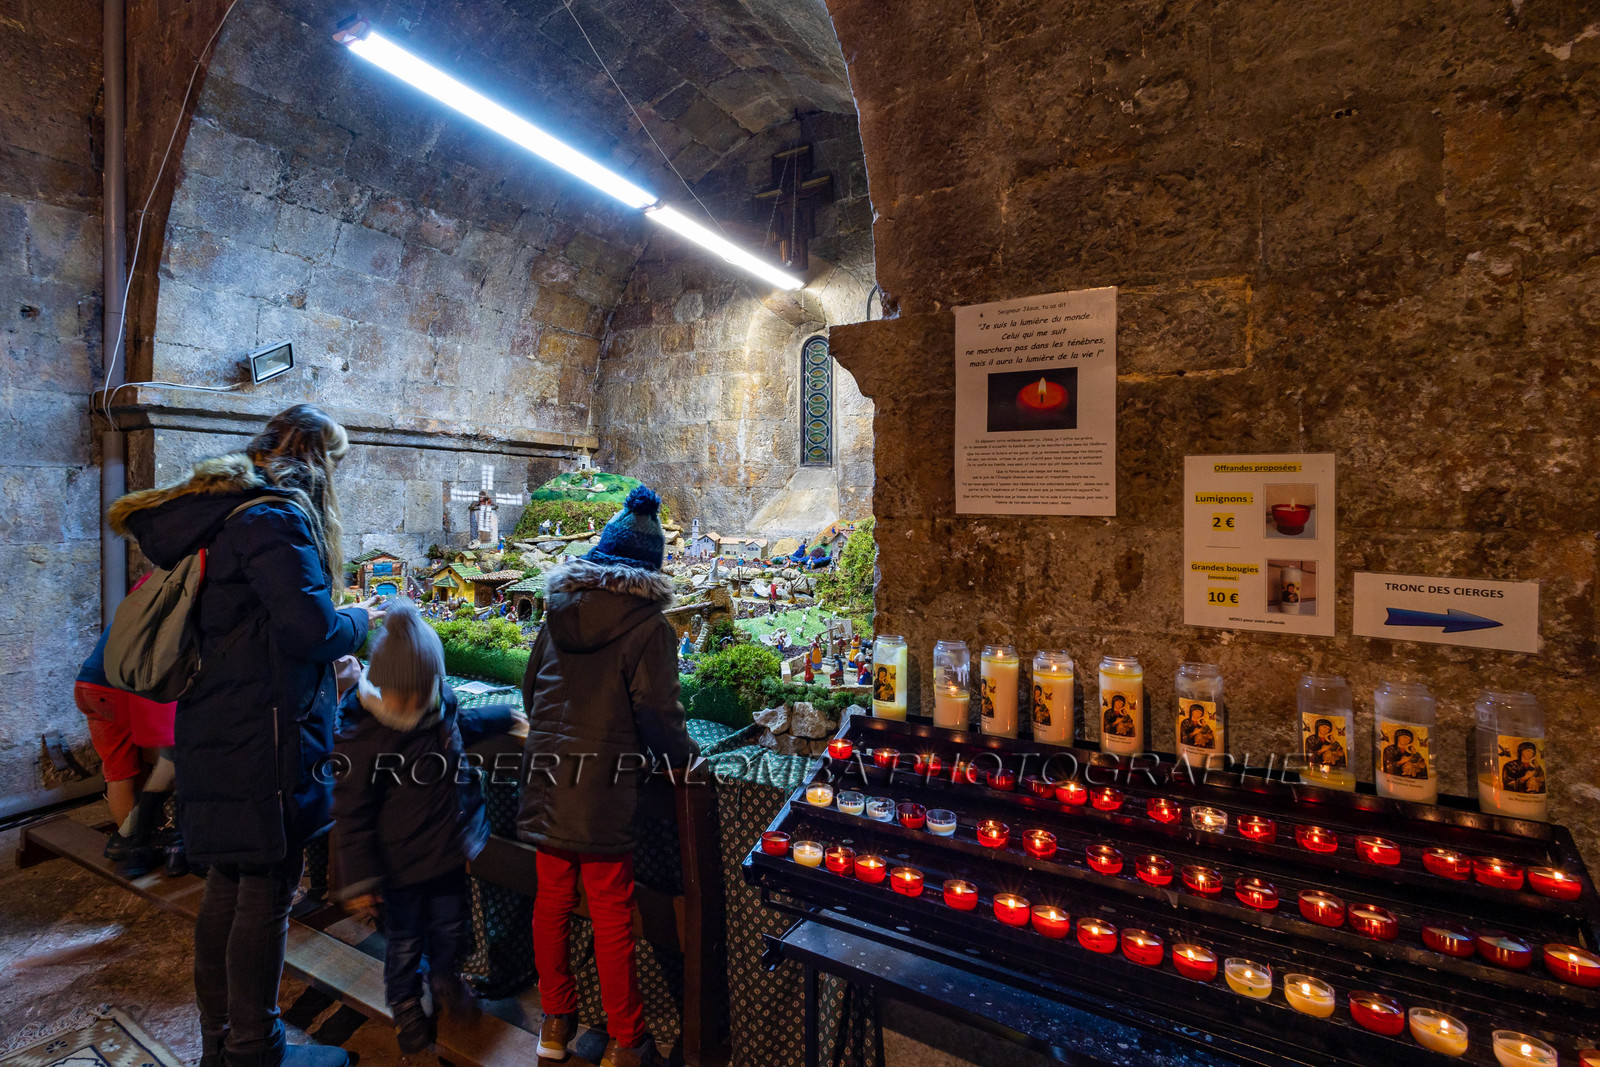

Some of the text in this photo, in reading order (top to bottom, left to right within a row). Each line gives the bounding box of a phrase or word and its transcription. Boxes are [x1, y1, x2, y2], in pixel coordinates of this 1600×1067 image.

[993, 321, 1008, 329] suis
[1010, 319, 1018, 327] la
[1019, 316, 1049, 326] lumière
[1051, 314, 1062, 323] du
[1064, 312, 1093, 321] monde.
[1001, 331, 1021, 340] Celui
[1022, 330, 1034, 340] qui
[1050, 327, 1067, 336] suit
[976, 345, 1013, 355] marchera
[1013, 344, 1028, 353] pas
[1030, 342, 1049, 350] dans
[1051, 340, 1064, 348] les
[1067, 337, 1106, 346] ténèbres,
[969, 359, 986, 368] mais
[988, 358, 995, 366] il
[1015, 355, 1023, 364] la
[1025, 353, 1055, 363] lumière
[1057, 352, 1068, 360] de
[1070, 351, 1079, 359] la
[1081, 350, 1094, 358] vie
[1213, 464, 1253, 472] Offrandes
[1254, 463, 1297, 473] proposées
[1195, 494, 1248, 504] Lumignons
[1212, 517, 1235, 528] 2 €
[1191, 563, 1259, 574] Grandes bougies
[1384, 582, 1504, 599] TRONC DES CIERGES
[1208, 591, 1239, 604] 10 €
